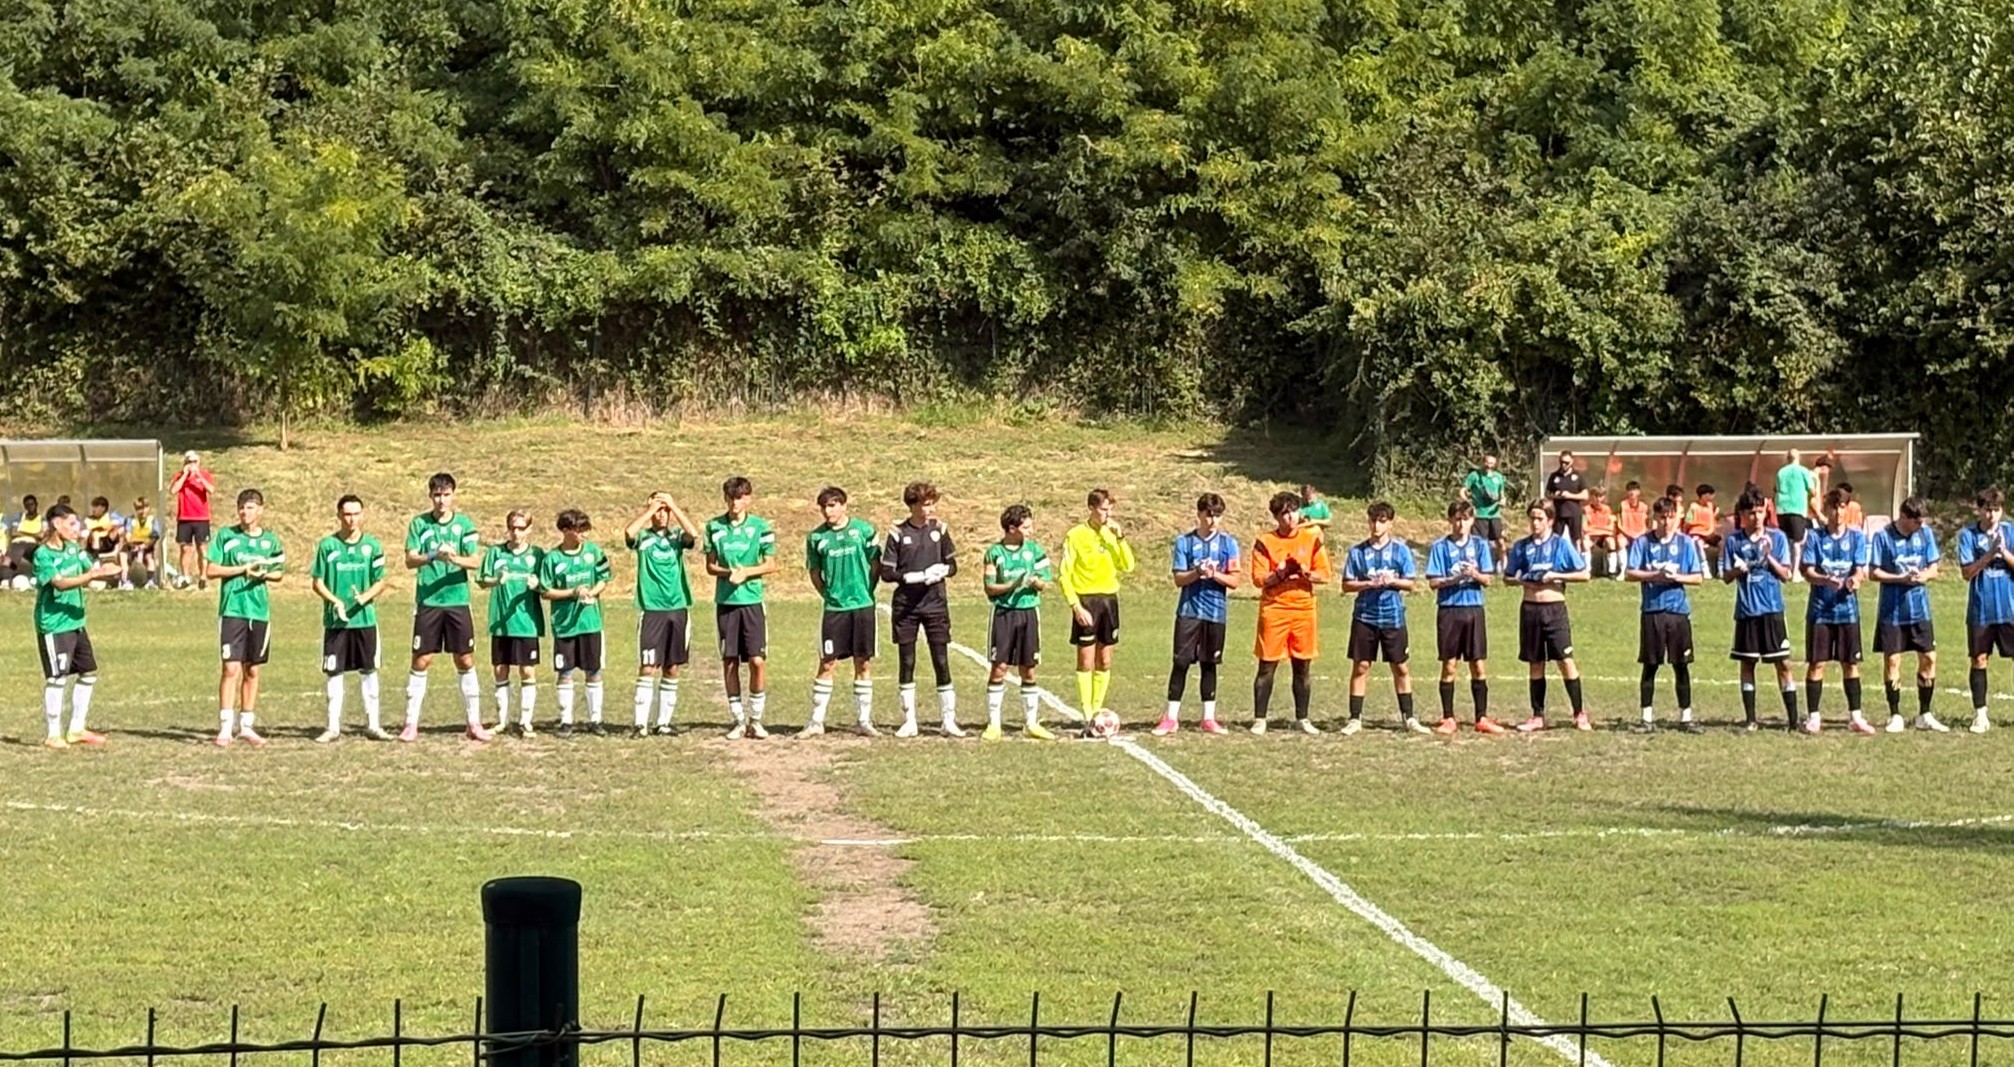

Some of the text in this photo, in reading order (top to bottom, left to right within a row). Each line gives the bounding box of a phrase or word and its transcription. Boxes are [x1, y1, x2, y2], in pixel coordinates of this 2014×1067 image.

[57, 652, 67, 670] 7
[323, 653, 336, 671] 10
[642, 648, 655, 665] 11
[991, 646, 998, 661] 2
